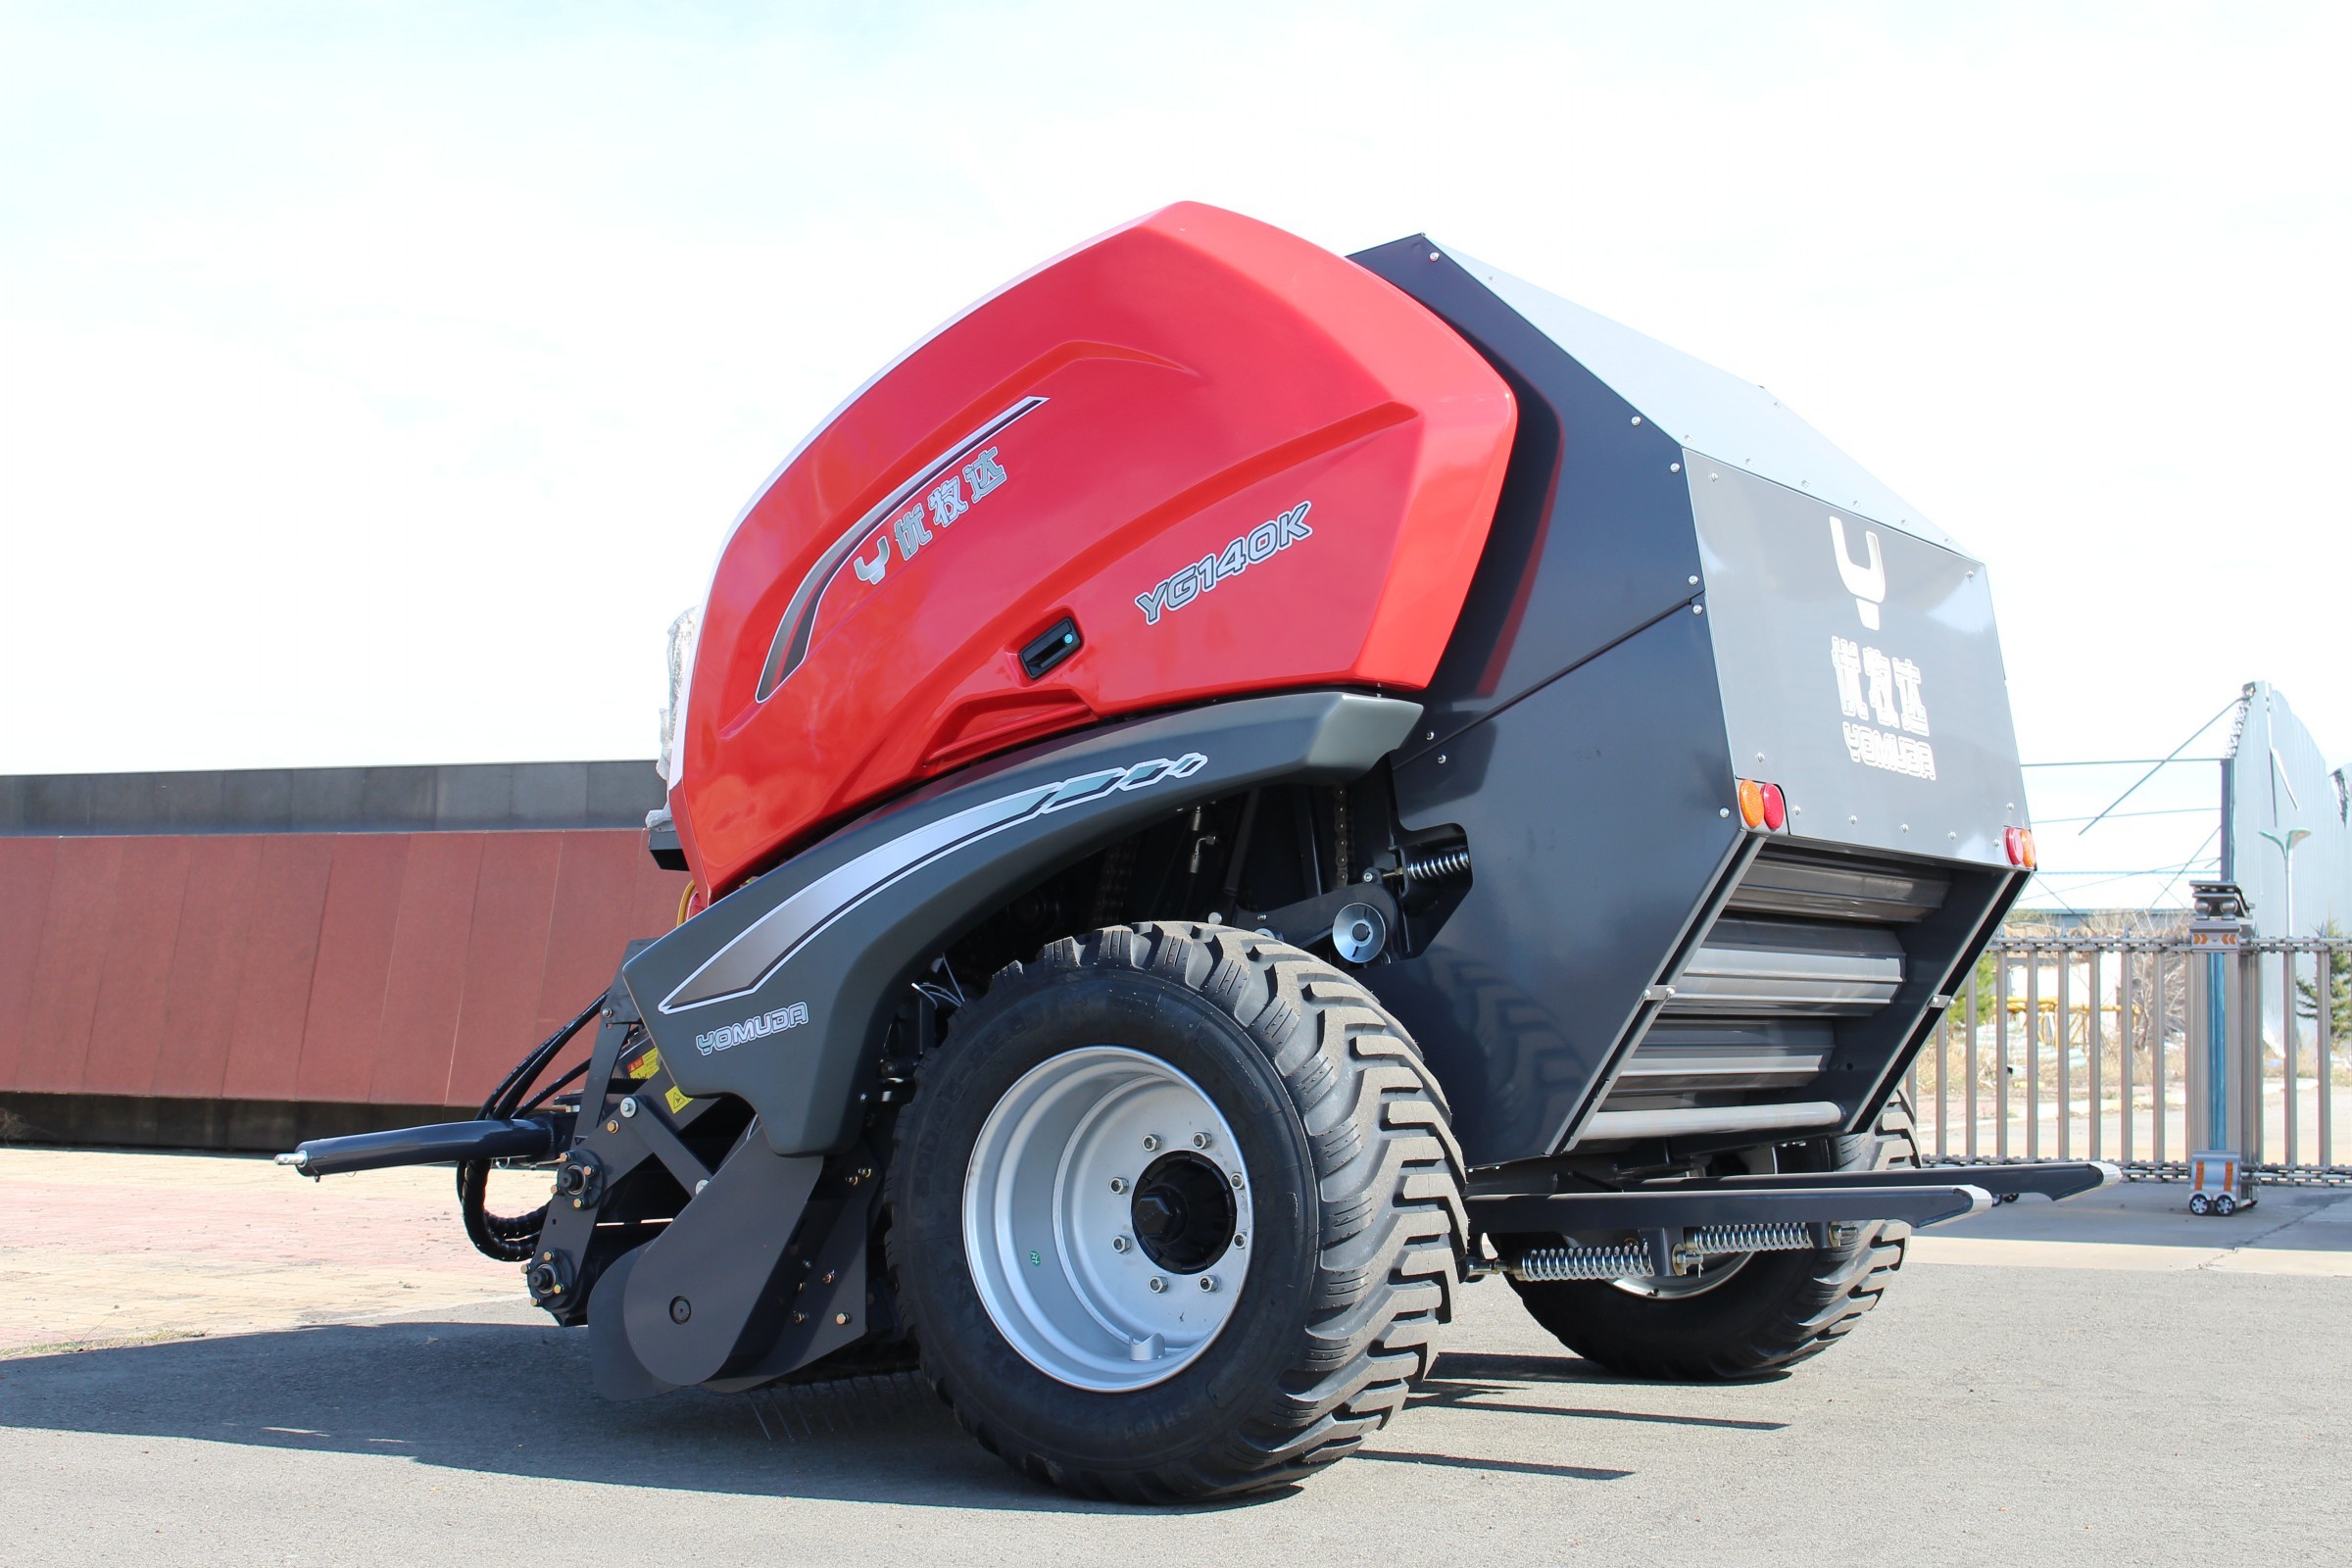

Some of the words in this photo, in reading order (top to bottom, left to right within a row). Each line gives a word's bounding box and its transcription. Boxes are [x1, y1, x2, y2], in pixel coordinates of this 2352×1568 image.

[894, 446, 1007, 561] 优牧达
[1135, 501, 1312, 625] YG140K
[1831, 635, 1930, 737] 优牧达
[1842, 720, 1936, 781] YOMUDA
[696, 1002, 808, 1055] YOMUDA
